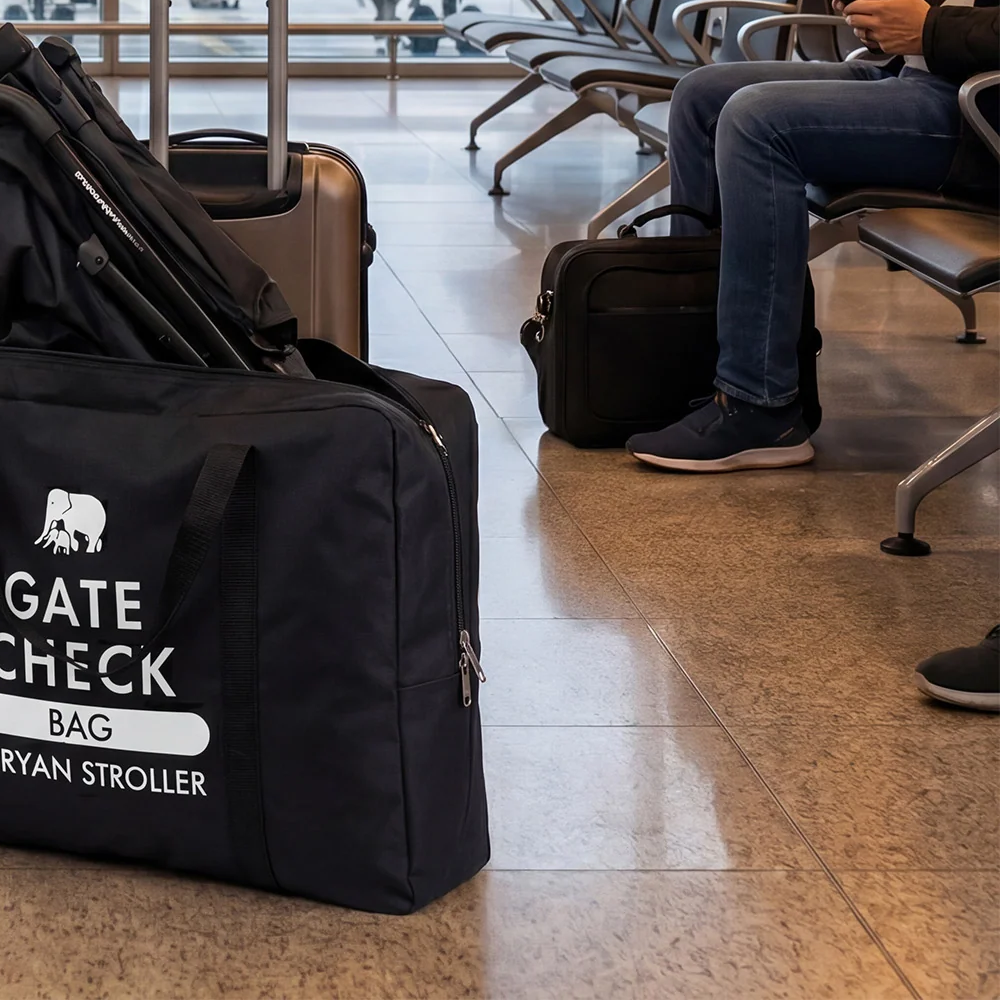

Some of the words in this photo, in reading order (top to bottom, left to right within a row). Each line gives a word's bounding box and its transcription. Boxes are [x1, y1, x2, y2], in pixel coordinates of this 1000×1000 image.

[4, 570, 142, 631] GATE
[48, 708, 113, 742] BAG
[82, 760, 208, 797] STROLLER
